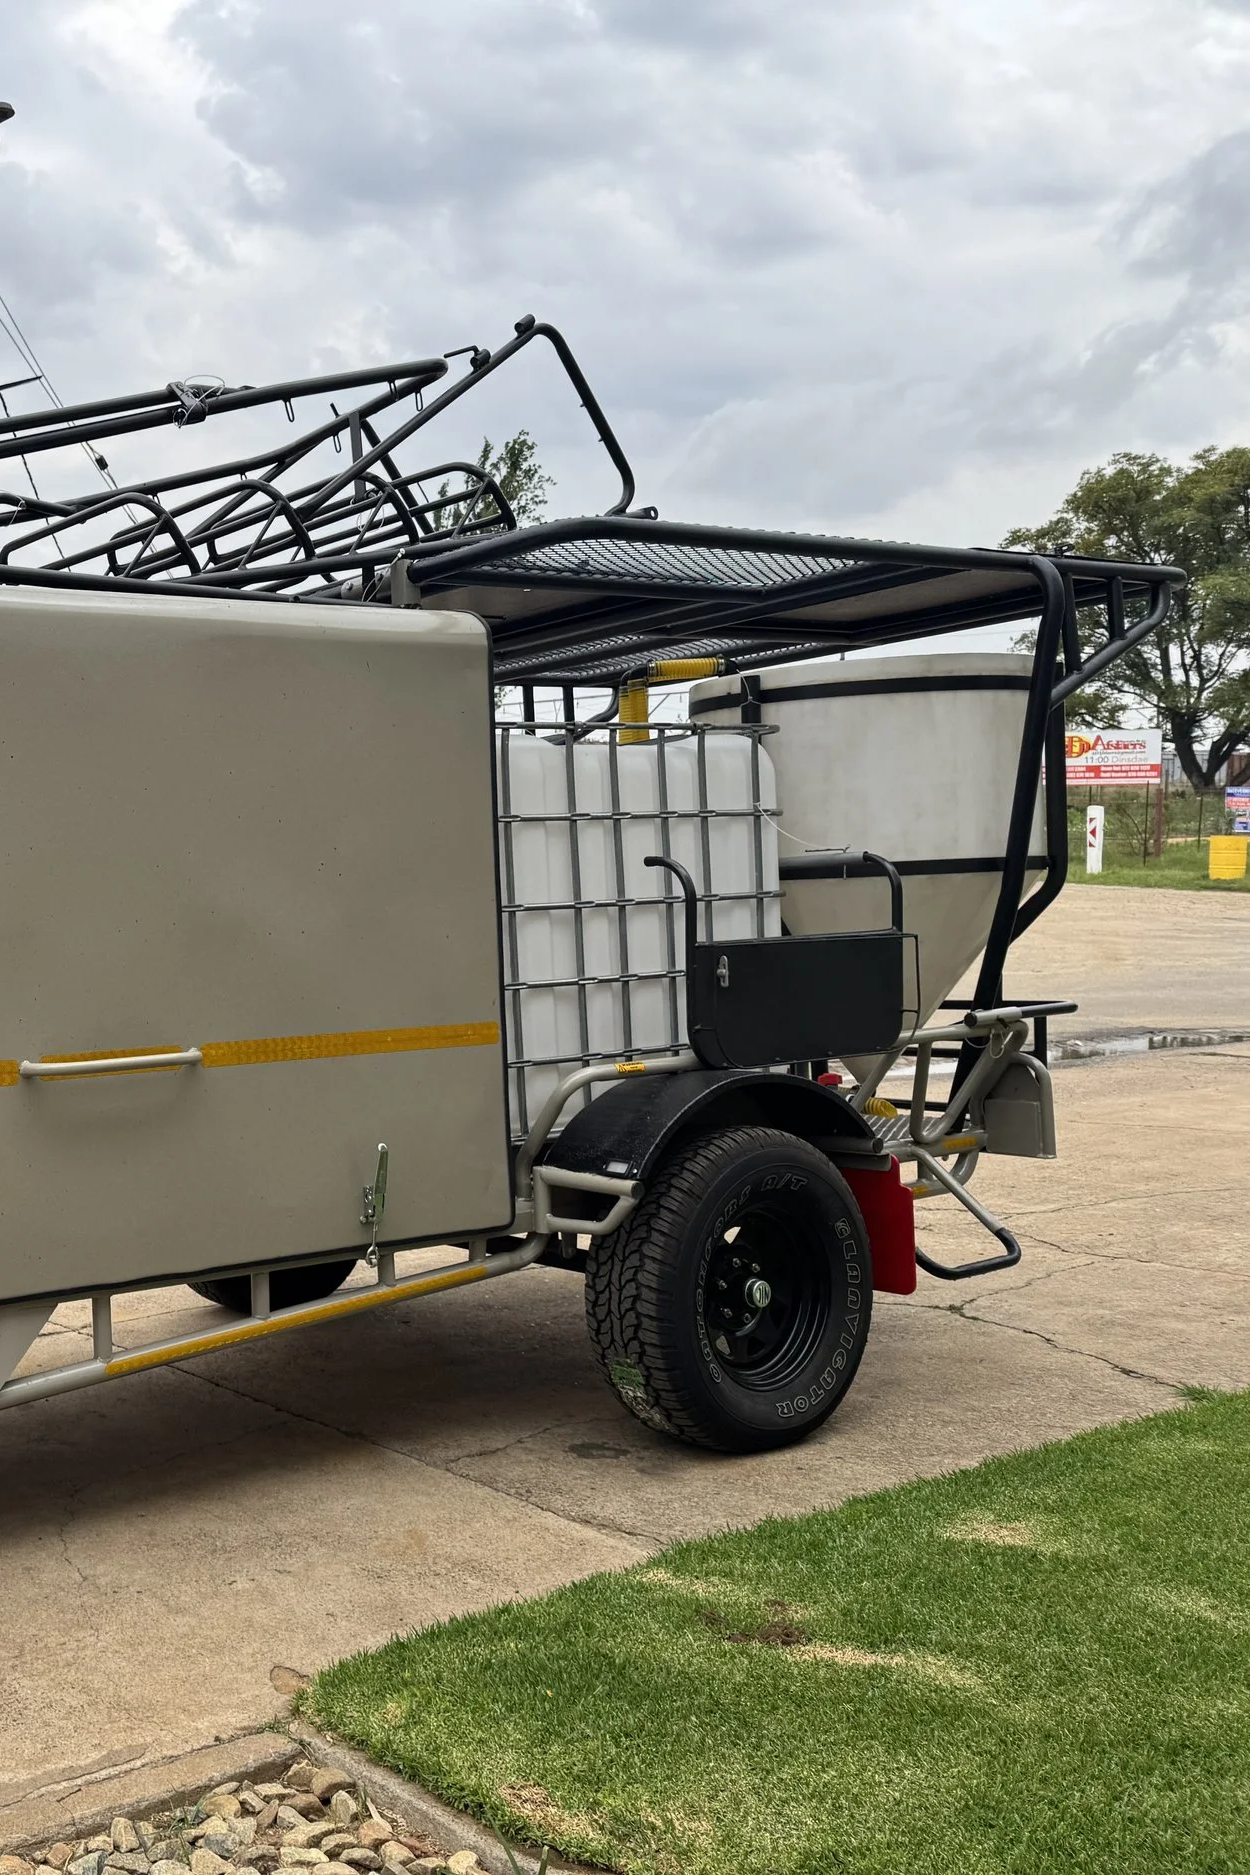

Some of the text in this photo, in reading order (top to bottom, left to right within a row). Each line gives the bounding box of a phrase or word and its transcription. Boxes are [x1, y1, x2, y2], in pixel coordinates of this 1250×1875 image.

[1085, 756, 1109, 764] 11:00
[761, 1173, 809, 1191] A/T
[776, 1240, 861, 1418] LANVIGATOR
